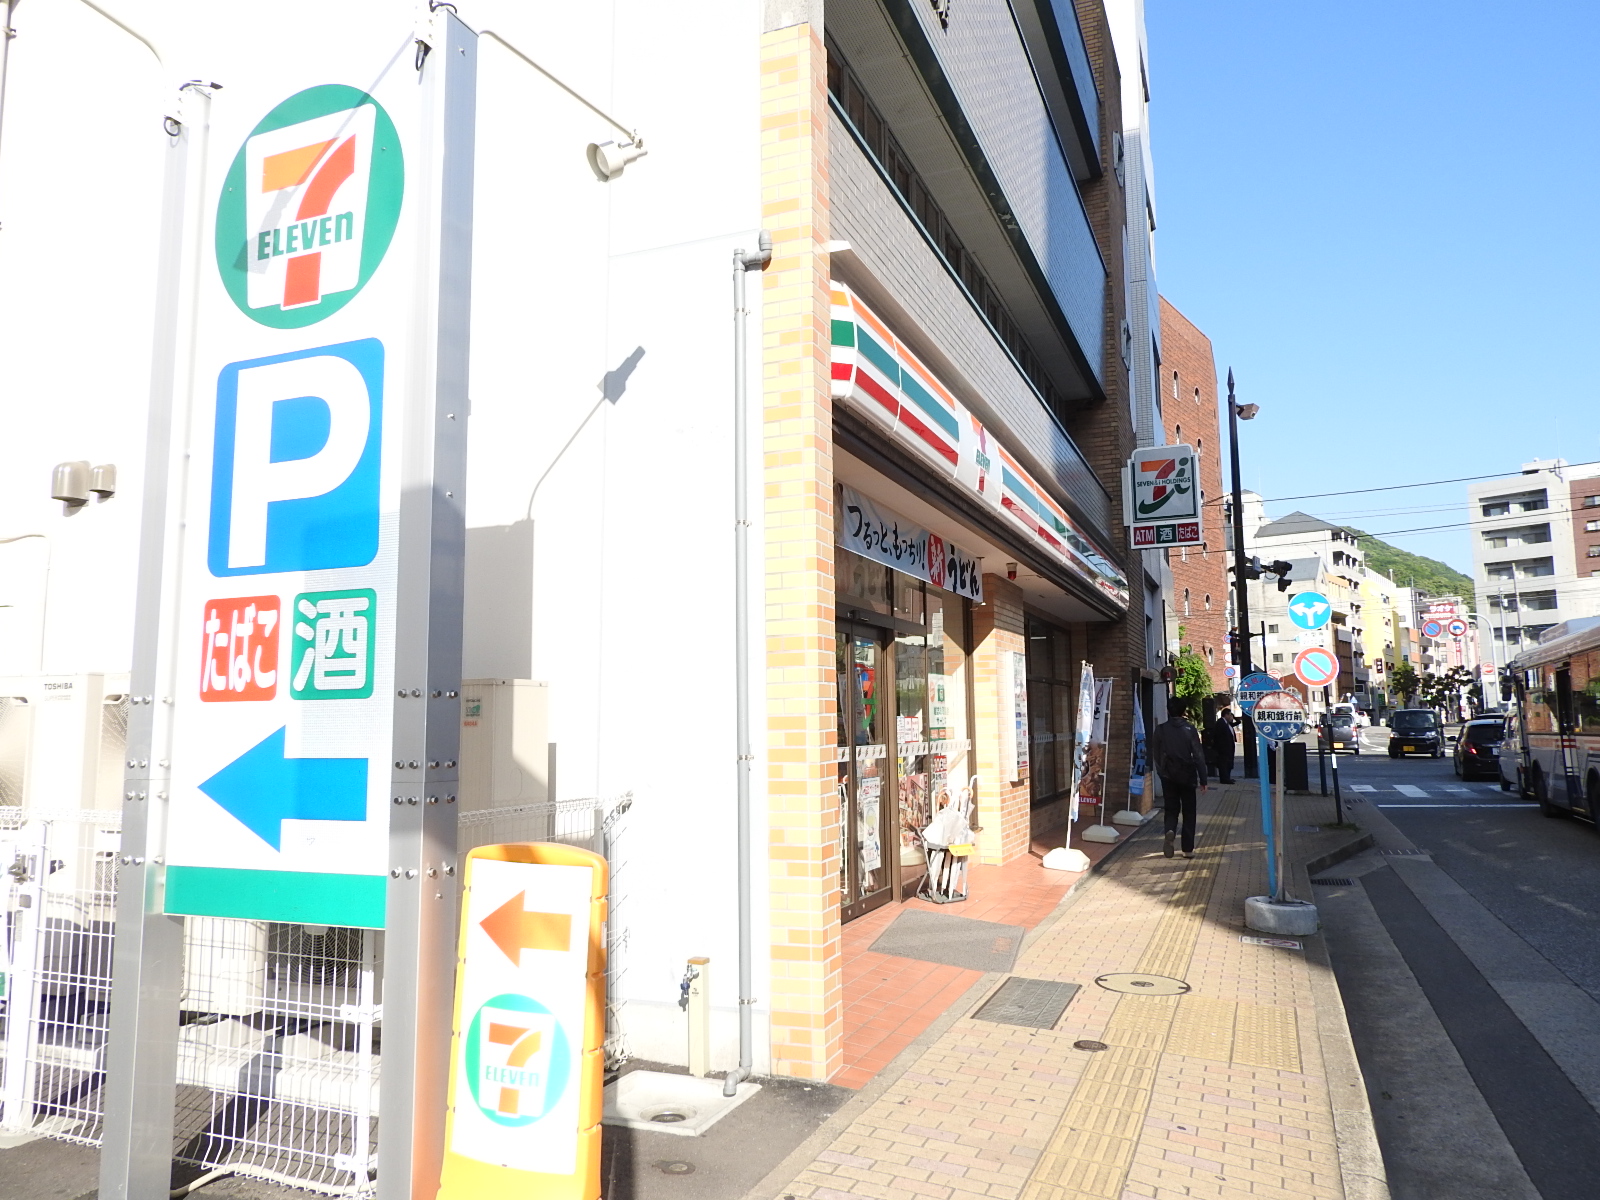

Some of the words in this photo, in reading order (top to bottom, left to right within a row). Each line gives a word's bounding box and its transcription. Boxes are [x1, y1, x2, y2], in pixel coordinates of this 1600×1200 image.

[229, 355, 371, 568] P
[1162, 476, 1191, 485] HOLDINGS
[1135, 529, 1154, 543] ATM
[1160, 527, 1173, 541] 酒
[1178, 525, 1198, 540] たばこ
[947, 544, 980, 598] うどん
[202, 603, 279, 693] たばこ
[292, 597, 370, 692] 酒
[44, 682, 73, 690] TOSHIBA
[1257, 710, 1303, 721] 親和銀行前
[1262, 723, 1297, 738] のりば
